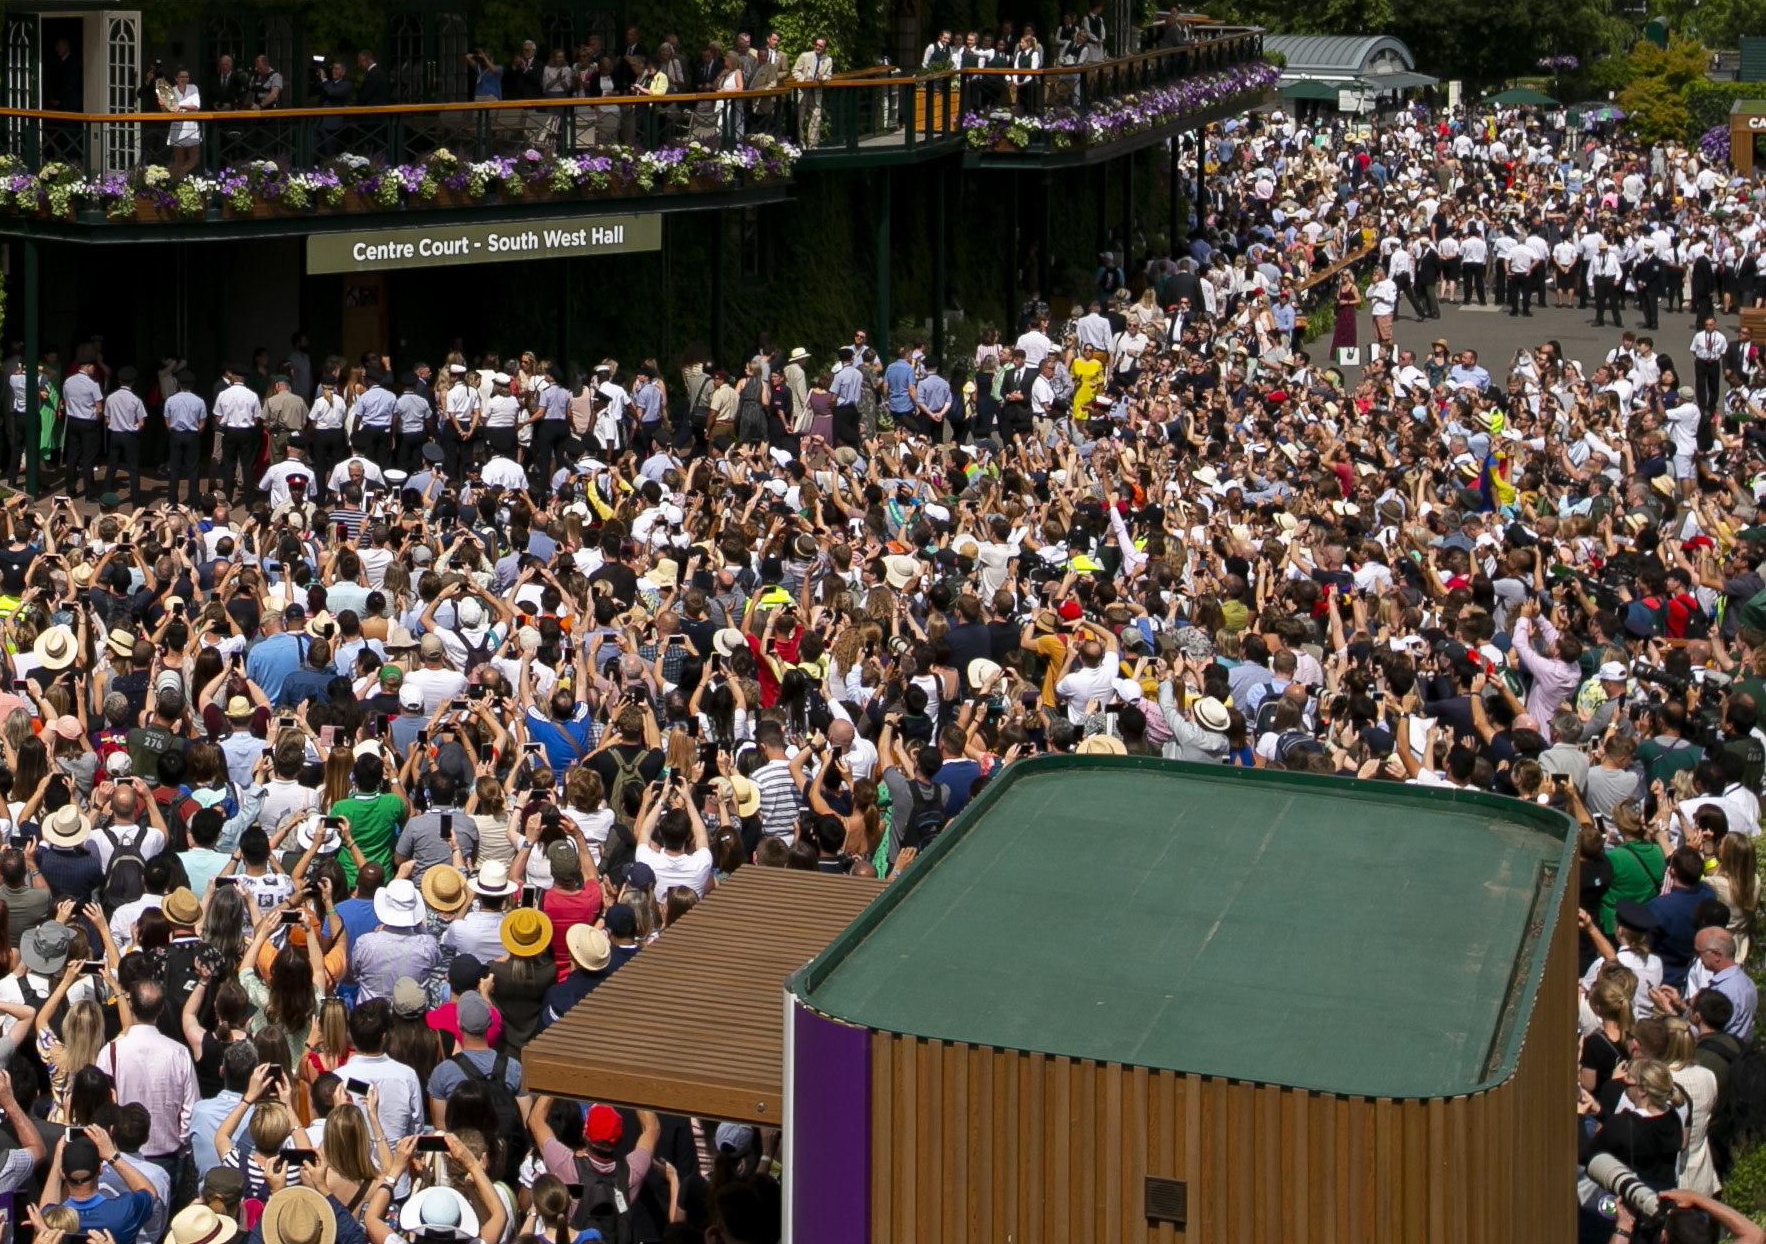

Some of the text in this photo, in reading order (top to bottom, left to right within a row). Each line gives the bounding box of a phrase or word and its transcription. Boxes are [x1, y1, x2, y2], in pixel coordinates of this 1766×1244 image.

[353, 241, 415, 261] Centre
[419, 236, 470, 257] Court
[487, 231, 539, 252] South
[543, 228, 587, 249] West
[591, 225, 624, 245] Hall
[143, 736, 163, 750] 276
